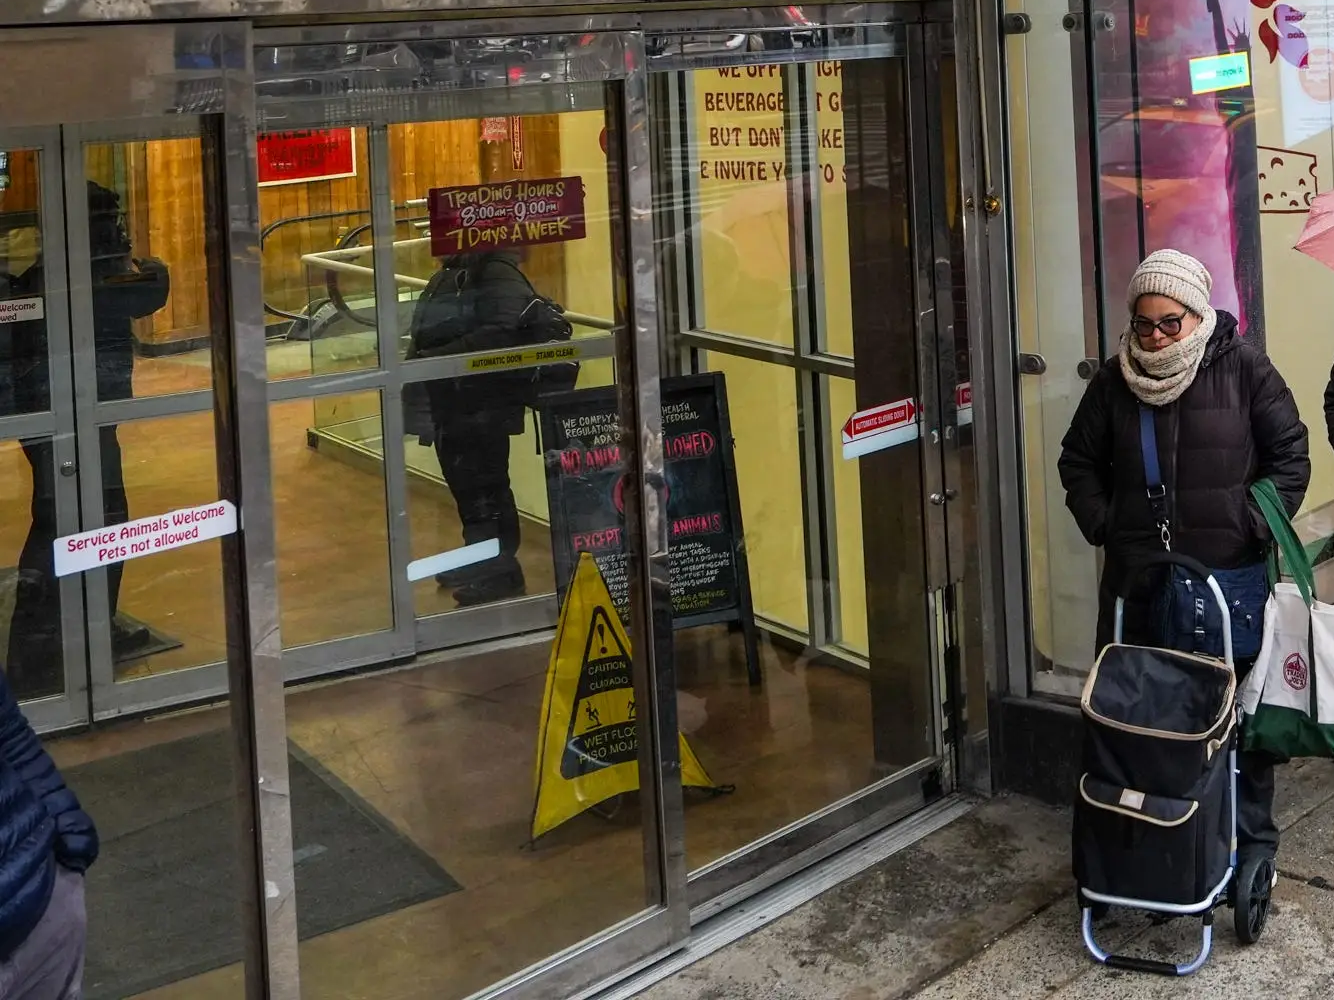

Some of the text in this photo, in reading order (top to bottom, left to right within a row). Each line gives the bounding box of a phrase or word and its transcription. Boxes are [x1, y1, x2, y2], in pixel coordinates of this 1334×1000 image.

[746, 64, 783, 78] OFF
[710, 127, 741, 147] BUT
[749, 126, 784, 148] DON'
[714, 160, 768, 181] INVITE
[446, 228, 464, 250] 7
[511, 223, 522, 243] A
[0, 302, 36, 313] Welcome
[472, 348, 574, 368] AUTOMATIC DOOR STAND CLEAR
[562, 418, 577, 430] WE
[579, 413, 613, 427] COMPLY
[661, 402, 690, 415] HEALTH
[565, 422, 619, 439] REGULATIONS
[665, 411, 701, 424] FEDERAL
[855, 409, 905, 430] AUTOMATIC SLIDING DOOR
[593, 433, 614, 446] ADA
[560, 431, 714, 476] NO ANIM LOWED
[67, 504, 225, 552] Service Animals Welcome
[573, 513, 723, 552] EXCEPT ANIMALS
[99, 526, 199, 562] Pets not allowed
[690, 547, 710, 555] TASKS
[588, 660, 626, 676] CAUTION
[589, 676, 629, 691] CUIDADO
[584, 725, 638, 750] WET FLOO
[578, 738, 639, 766] PISO MOJ
